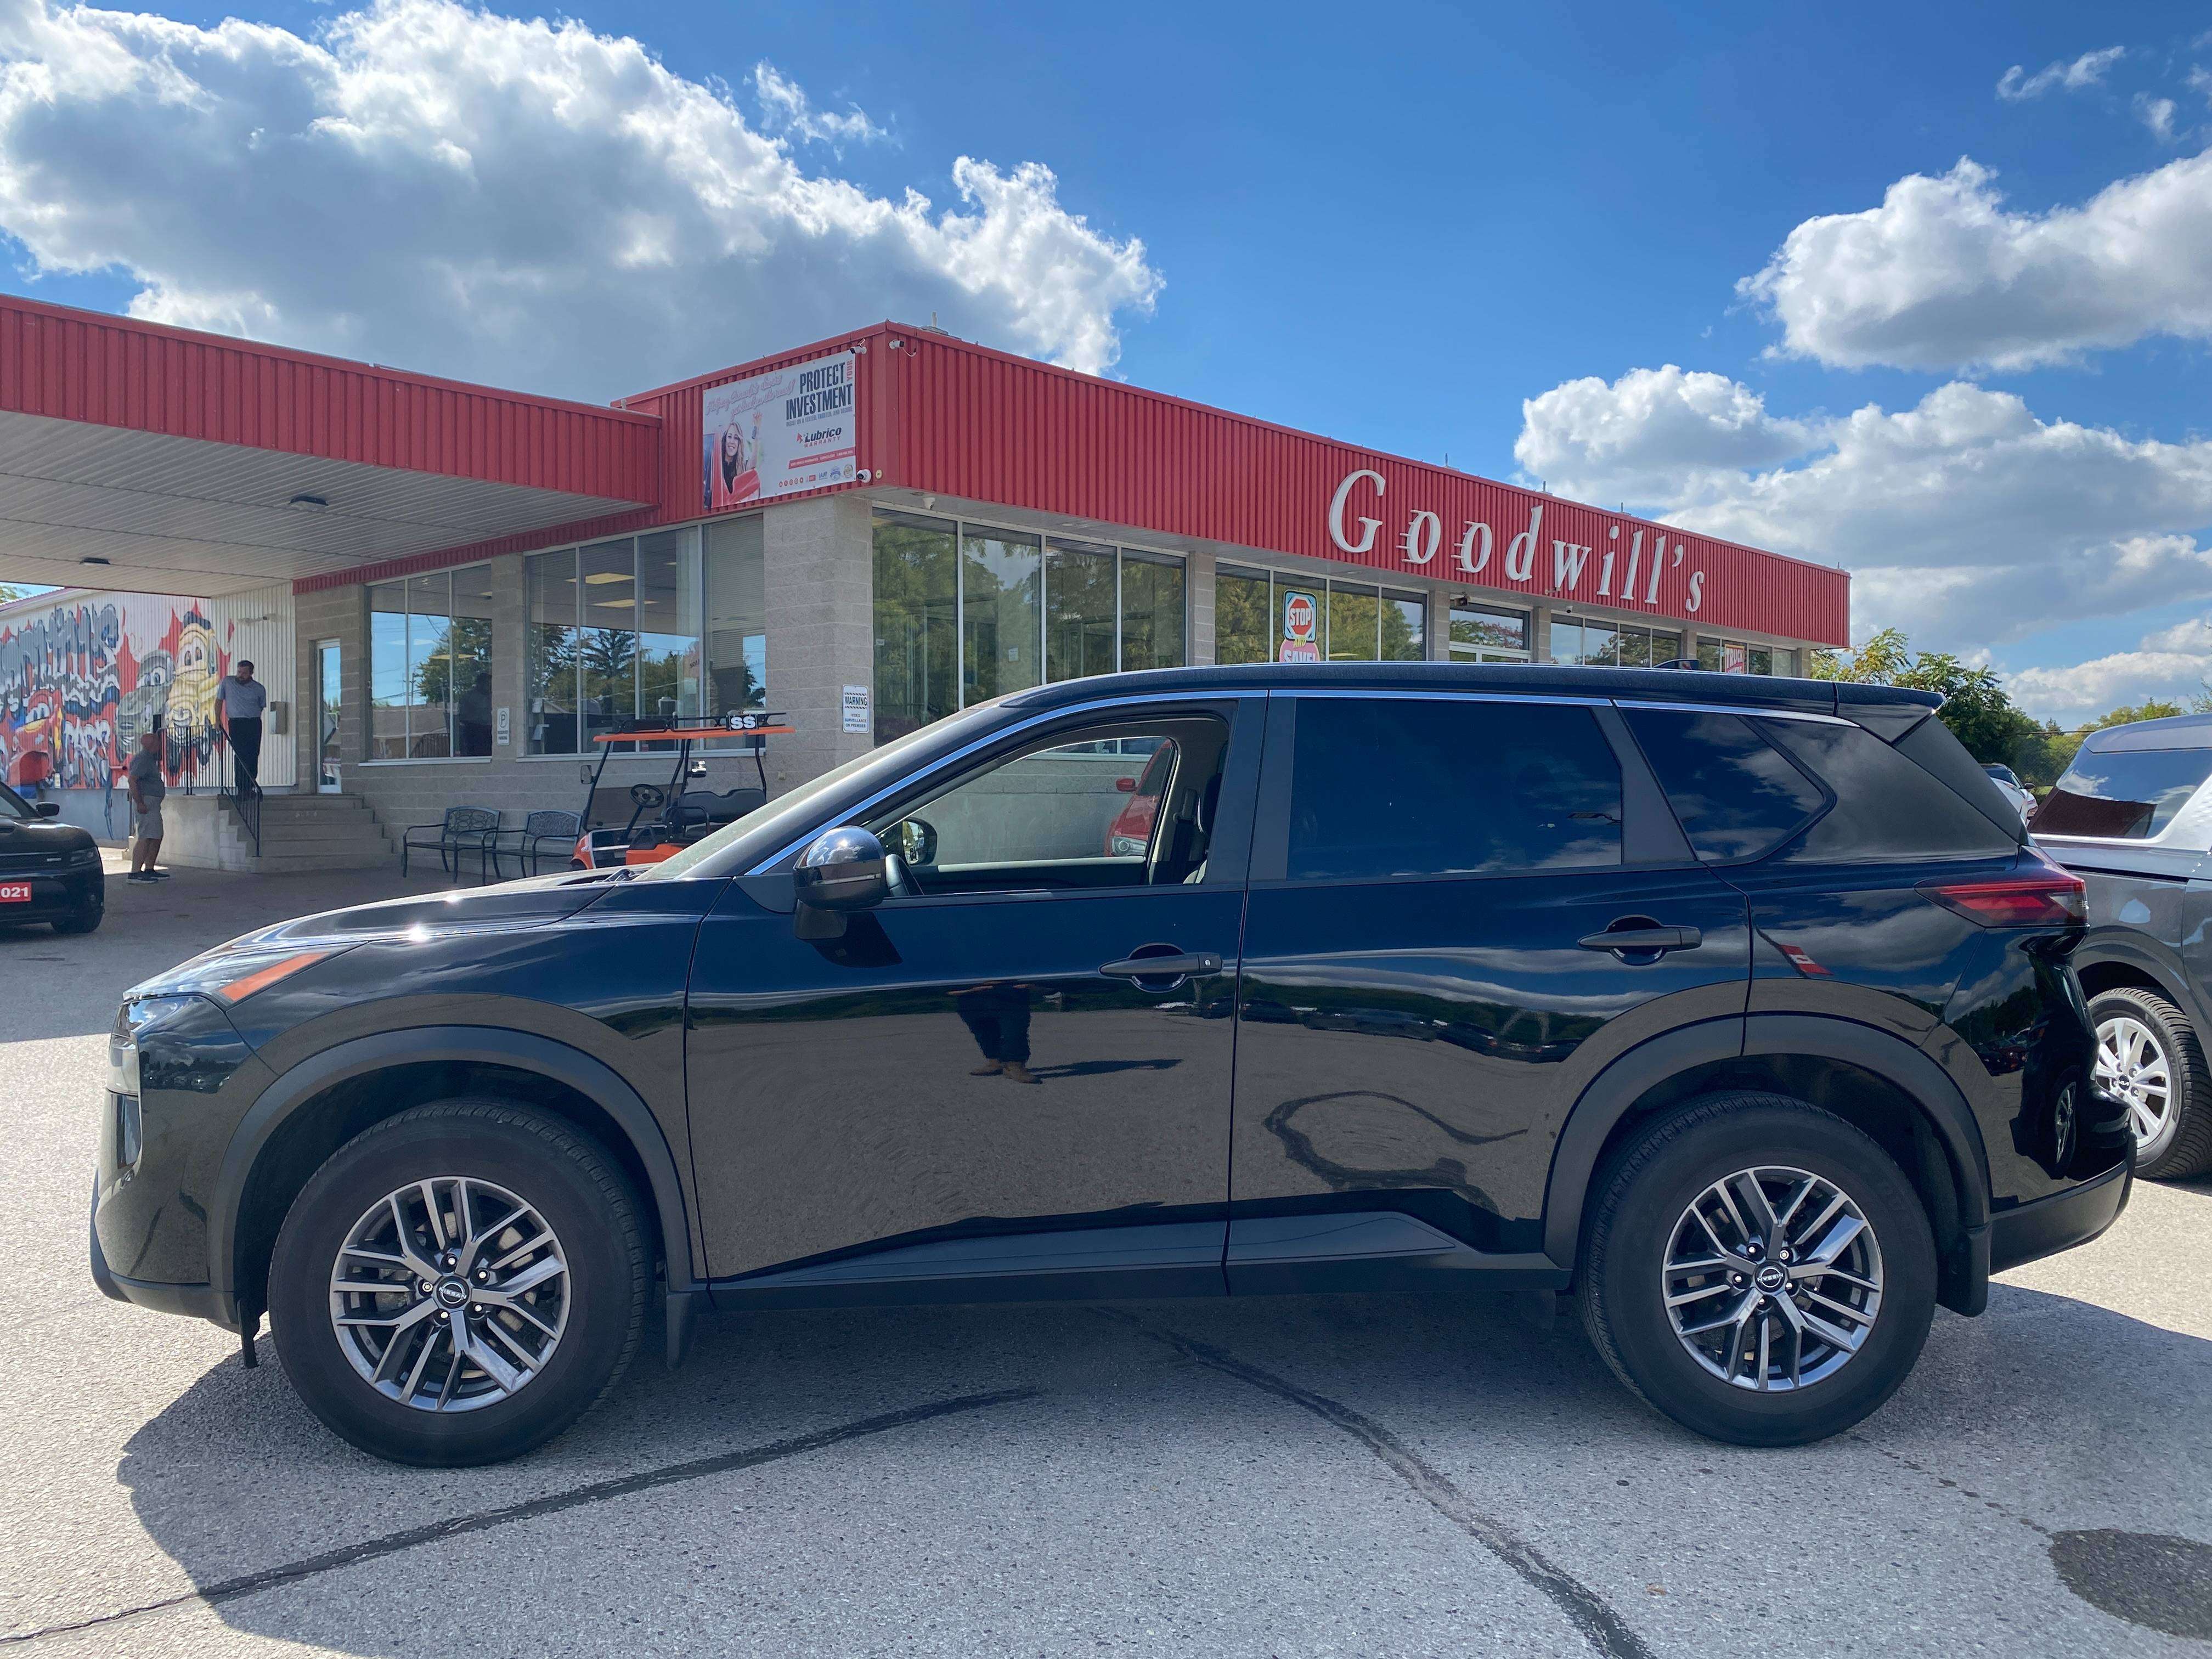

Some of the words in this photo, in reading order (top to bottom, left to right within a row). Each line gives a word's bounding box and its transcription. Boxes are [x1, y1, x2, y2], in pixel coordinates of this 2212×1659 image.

[800, 362, 845, 394] PROTECT
[786, 383, 853, 420] INVESTMENT
[804, 427, 842, 443] Lubrico
[804, 436, 841, 448] WARRANTY
[1328, 469, 1705, 613] Goodwill's
[1290, 608, 1311, 626] STOP
[1293, 637, 1306, 648] AND
[845, 696, 867, 706] WARNING
[501, 714, 505, 725] P
[731, 716, 755, 730] SS
[1758, 1273, 1783, 1282] NISSAN
[439, 1287, 466, 1299] NISSAN
